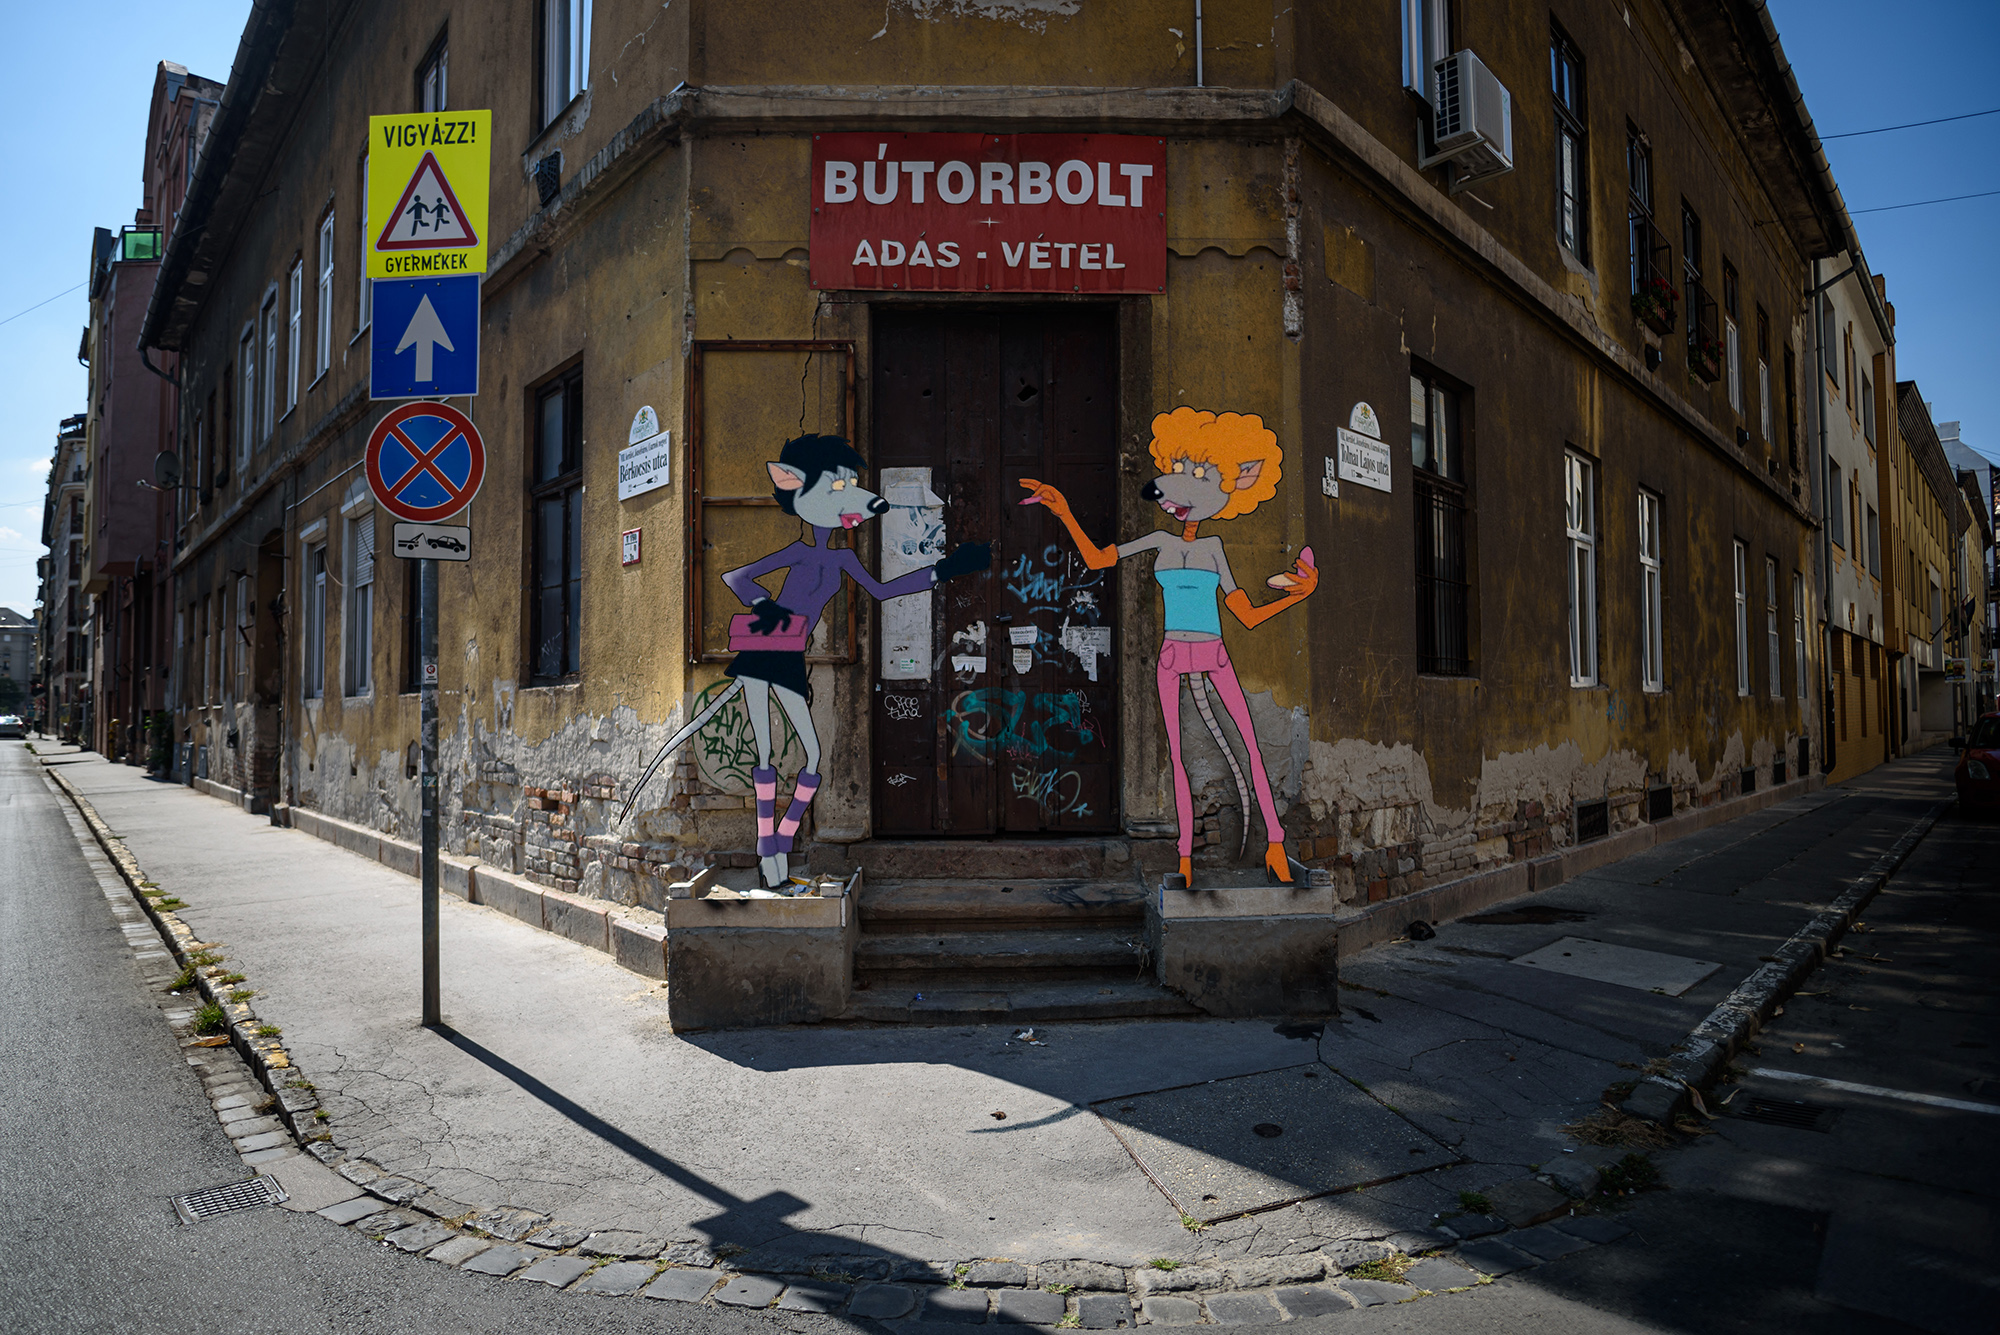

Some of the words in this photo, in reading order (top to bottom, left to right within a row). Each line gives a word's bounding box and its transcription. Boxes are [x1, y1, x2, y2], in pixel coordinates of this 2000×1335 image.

[384, 117, 476, 148] VIGYÁZZ!
[824, 143, 1154, 207] BÚTORBOLT
[385, 253, 468, 273] GYERMEKEK
[852, 231, 961, 268] ADÁS
[1001, 233, 1126, 270] VÉTEL
[620, 455, 651, 483] Bérkocsis
[652, 451, 667, 470] utca
[1341, 444, 1359, 467] Tolnai
[1360, 450, 1376, 474] Lajos
[1376, 459, 1389, 476] utca
